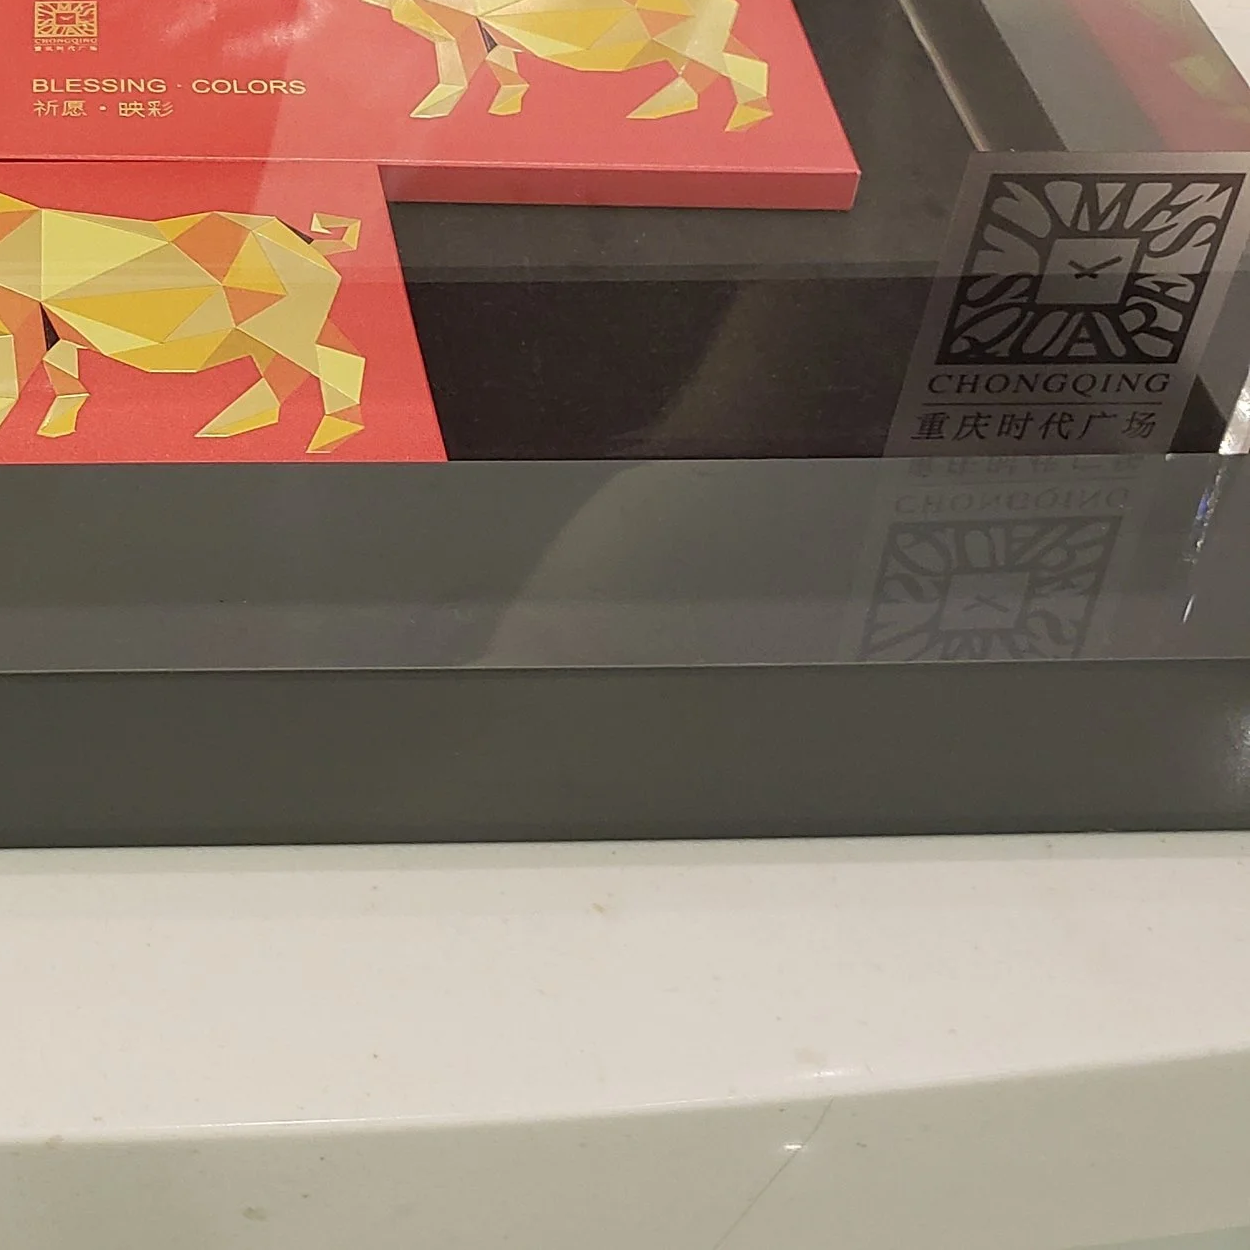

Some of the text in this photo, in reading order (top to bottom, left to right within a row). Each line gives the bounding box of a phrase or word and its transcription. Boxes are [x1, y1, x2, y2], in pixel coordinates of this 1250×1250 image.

[32, 78, 167, 94] BLESSING
[192, 79, 307, 95] COLORS
[927, 372, 1171, 396] CHONGQING
[910, 410, 1158, 442] 重庆时代广场
